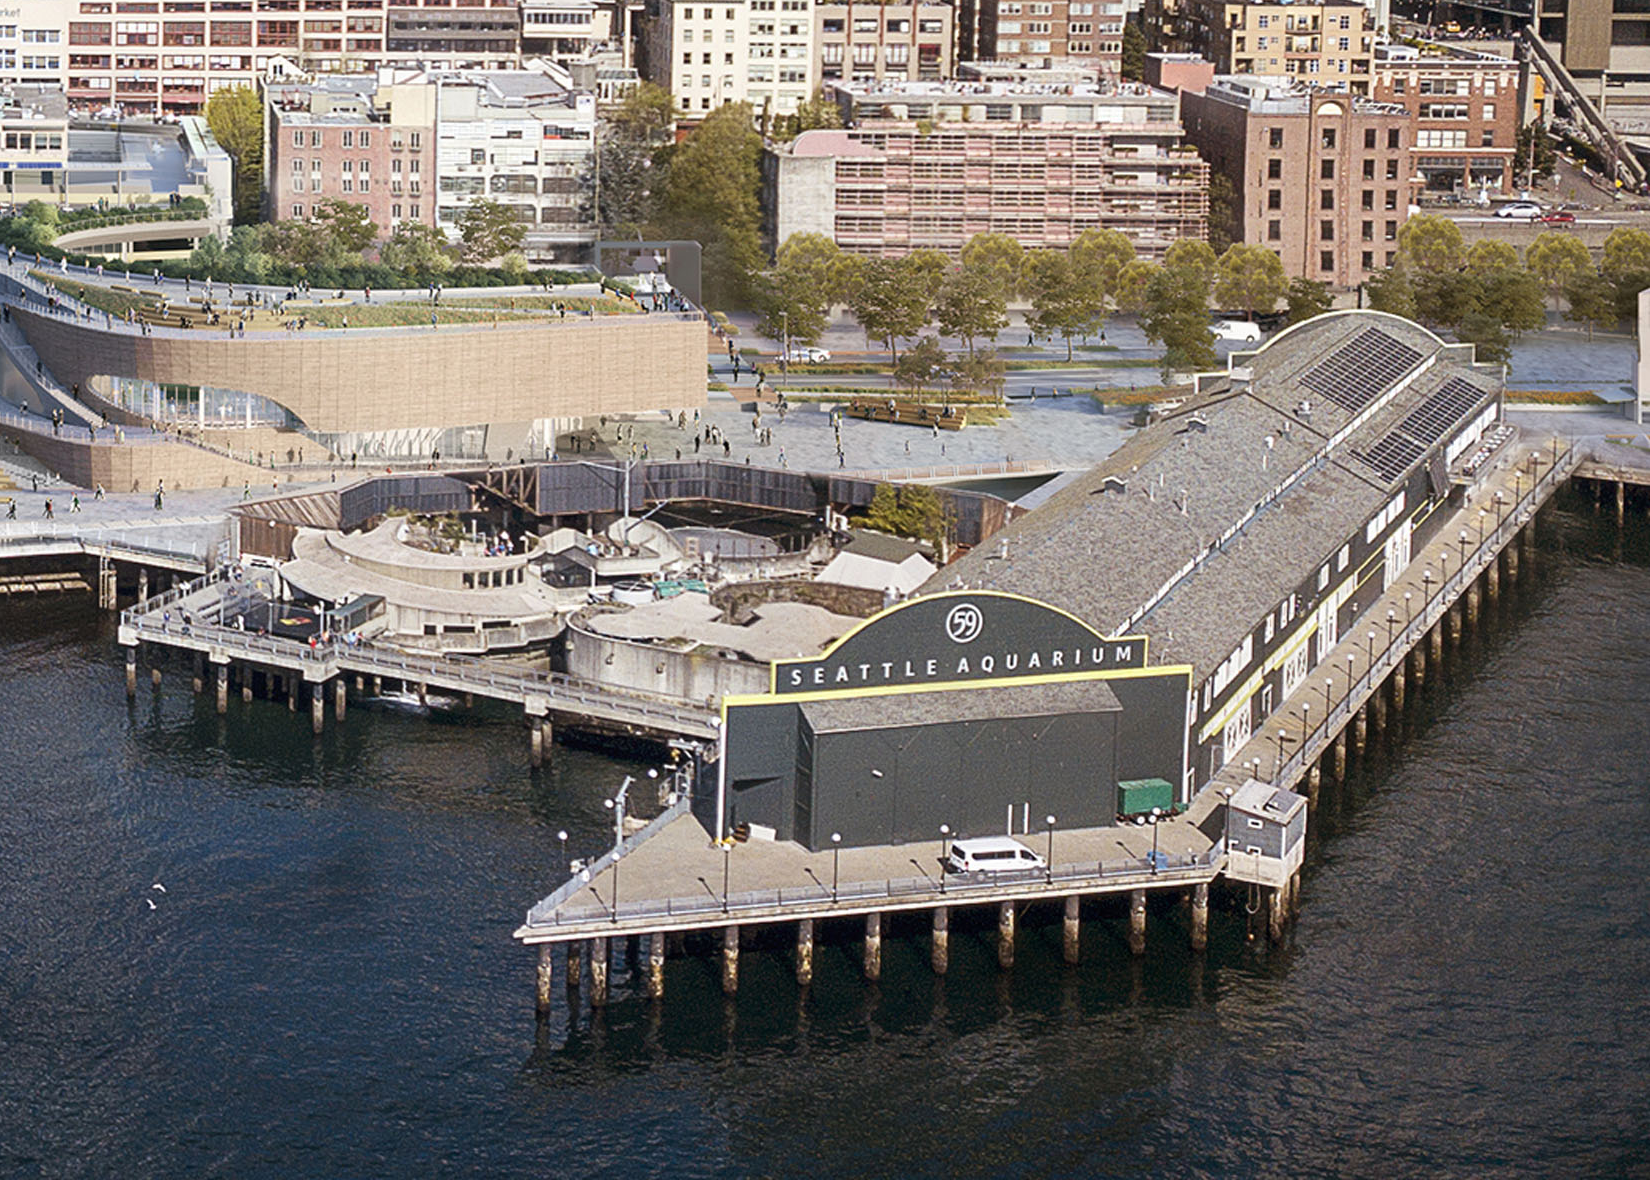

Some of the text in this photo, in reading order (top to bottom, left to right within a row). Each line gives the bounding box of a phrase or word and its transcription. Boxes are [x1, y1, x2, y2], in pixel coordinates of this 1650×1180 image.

[953, 610, 978, 637] 59
[791, 645, 1132, 686] SEATTLE AQUARIUM
